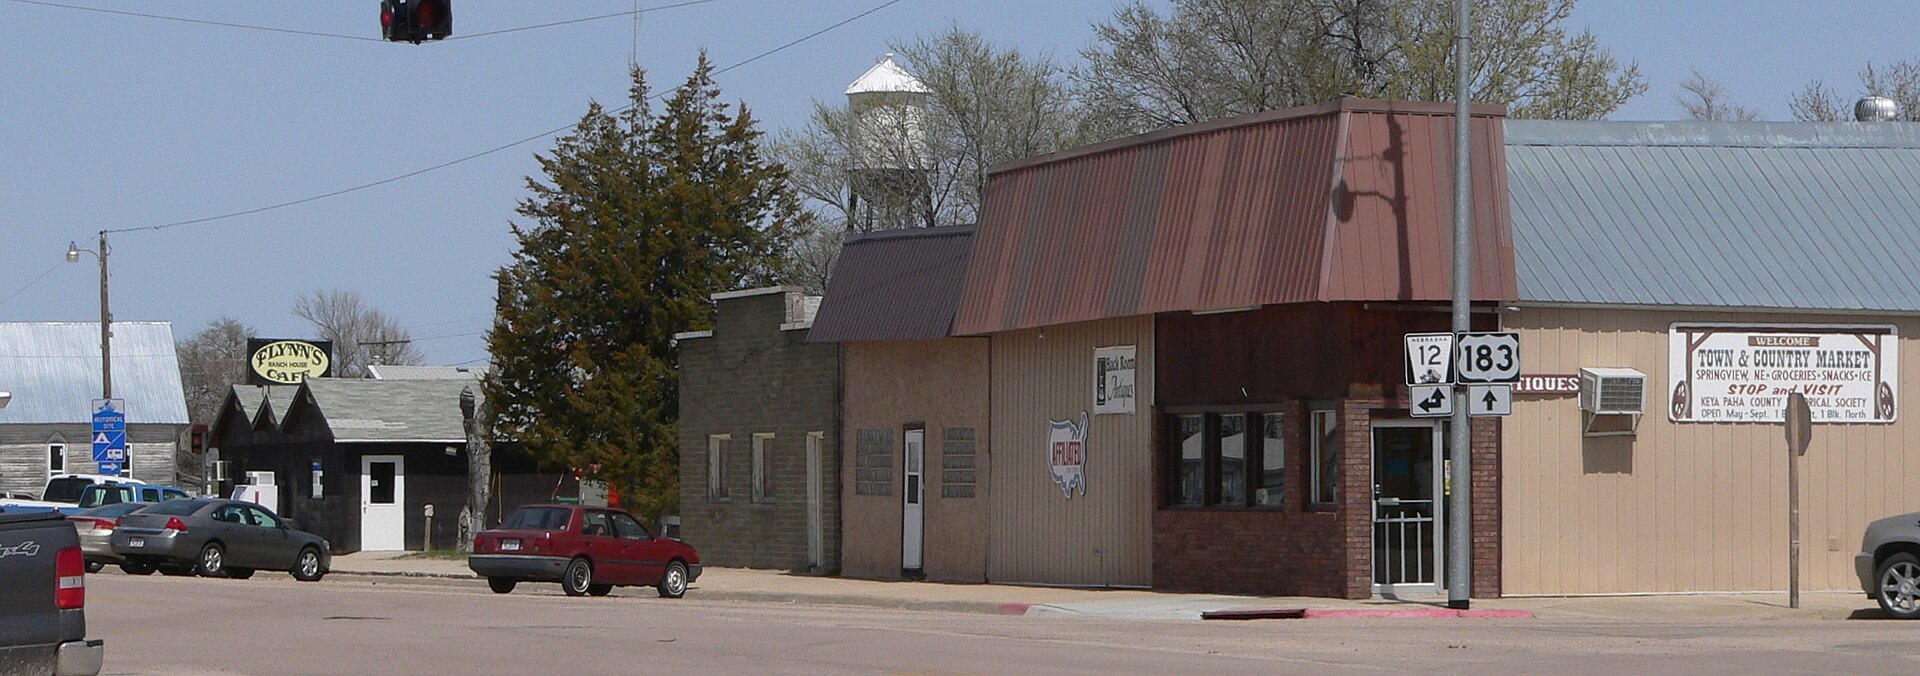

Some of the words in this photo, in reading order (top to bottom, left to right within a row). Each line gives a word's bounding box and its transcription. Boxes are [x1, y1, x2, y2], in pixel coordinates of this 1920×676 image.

[1756, 337, 1810, 346] WELCOME
[256, 343, 323, 368] FLYNN'S
[1418, 345, 1441, 366] 12
[1464, 344, 1513, 372] 183
[1698, 349, 1734, 367] TOWN
[1738, 349, 1750, 367] &
[1754, 349, 1811, 368] COUNTRY
[1816, 350, 1870, 368] MARKET
[1696, 369, 1749, 382] SPRINGVIEW,
[1511, 377, 1579, 391] TIQUES
[1727, 384, 1767, 395] STOP
[1772, 384, 1798, 395] and
[1803, 384, 1843, 395] VISIT
[1700, 396, 1720, 407] KEYA
[1723, 396, 1745, 407] PAHA
[1750, 396, 1782, 407] COUNTY
[1835, 397, 1867, 408] SOCIETY
[1701, 409, 1721, 418] OPEN
[1845, 410, 1866, 418] North
